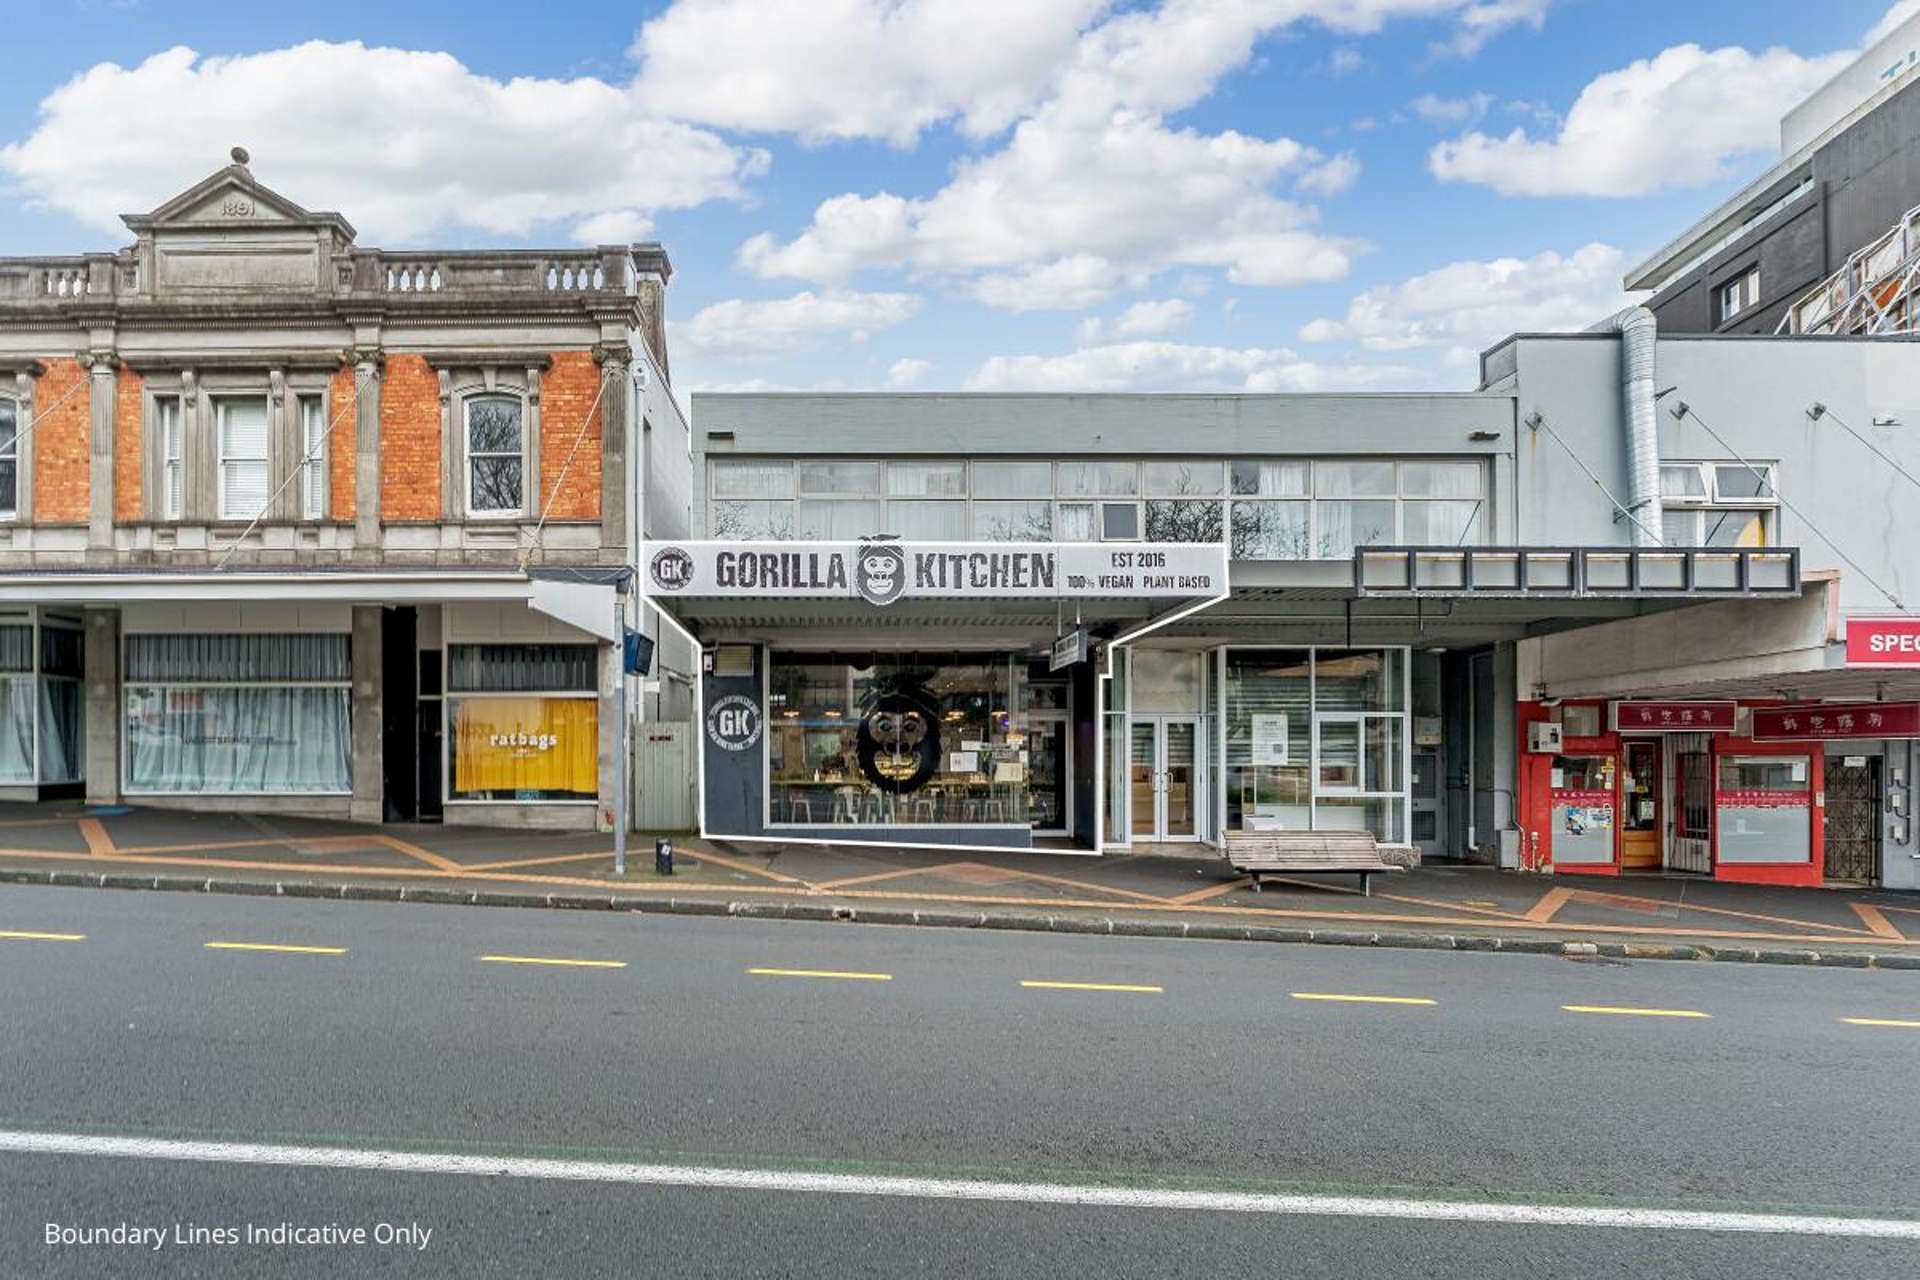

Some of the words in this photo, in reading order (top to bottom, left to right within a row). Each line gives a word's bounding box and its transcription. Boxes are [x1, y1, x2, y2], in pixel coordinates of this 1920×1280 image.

[660, 559, 684, 579] GK
[1111, 552, 1133, 568] EST
[1137, 552, 1166, 568] 2016
[716, 552, 847, 588] GORILLA
[915, 553, 1055, 589] KITCHEN
[1067, 575, 1095, 589] 100%
[1099, 575, 1134, 589] VEGAN
[1143, 575, 1175, 589] PLANT
[1178, 575, 1211, 589] BASED
[720, 710, 750, 736] GK
[490, 733, 558, 750] ratbags
